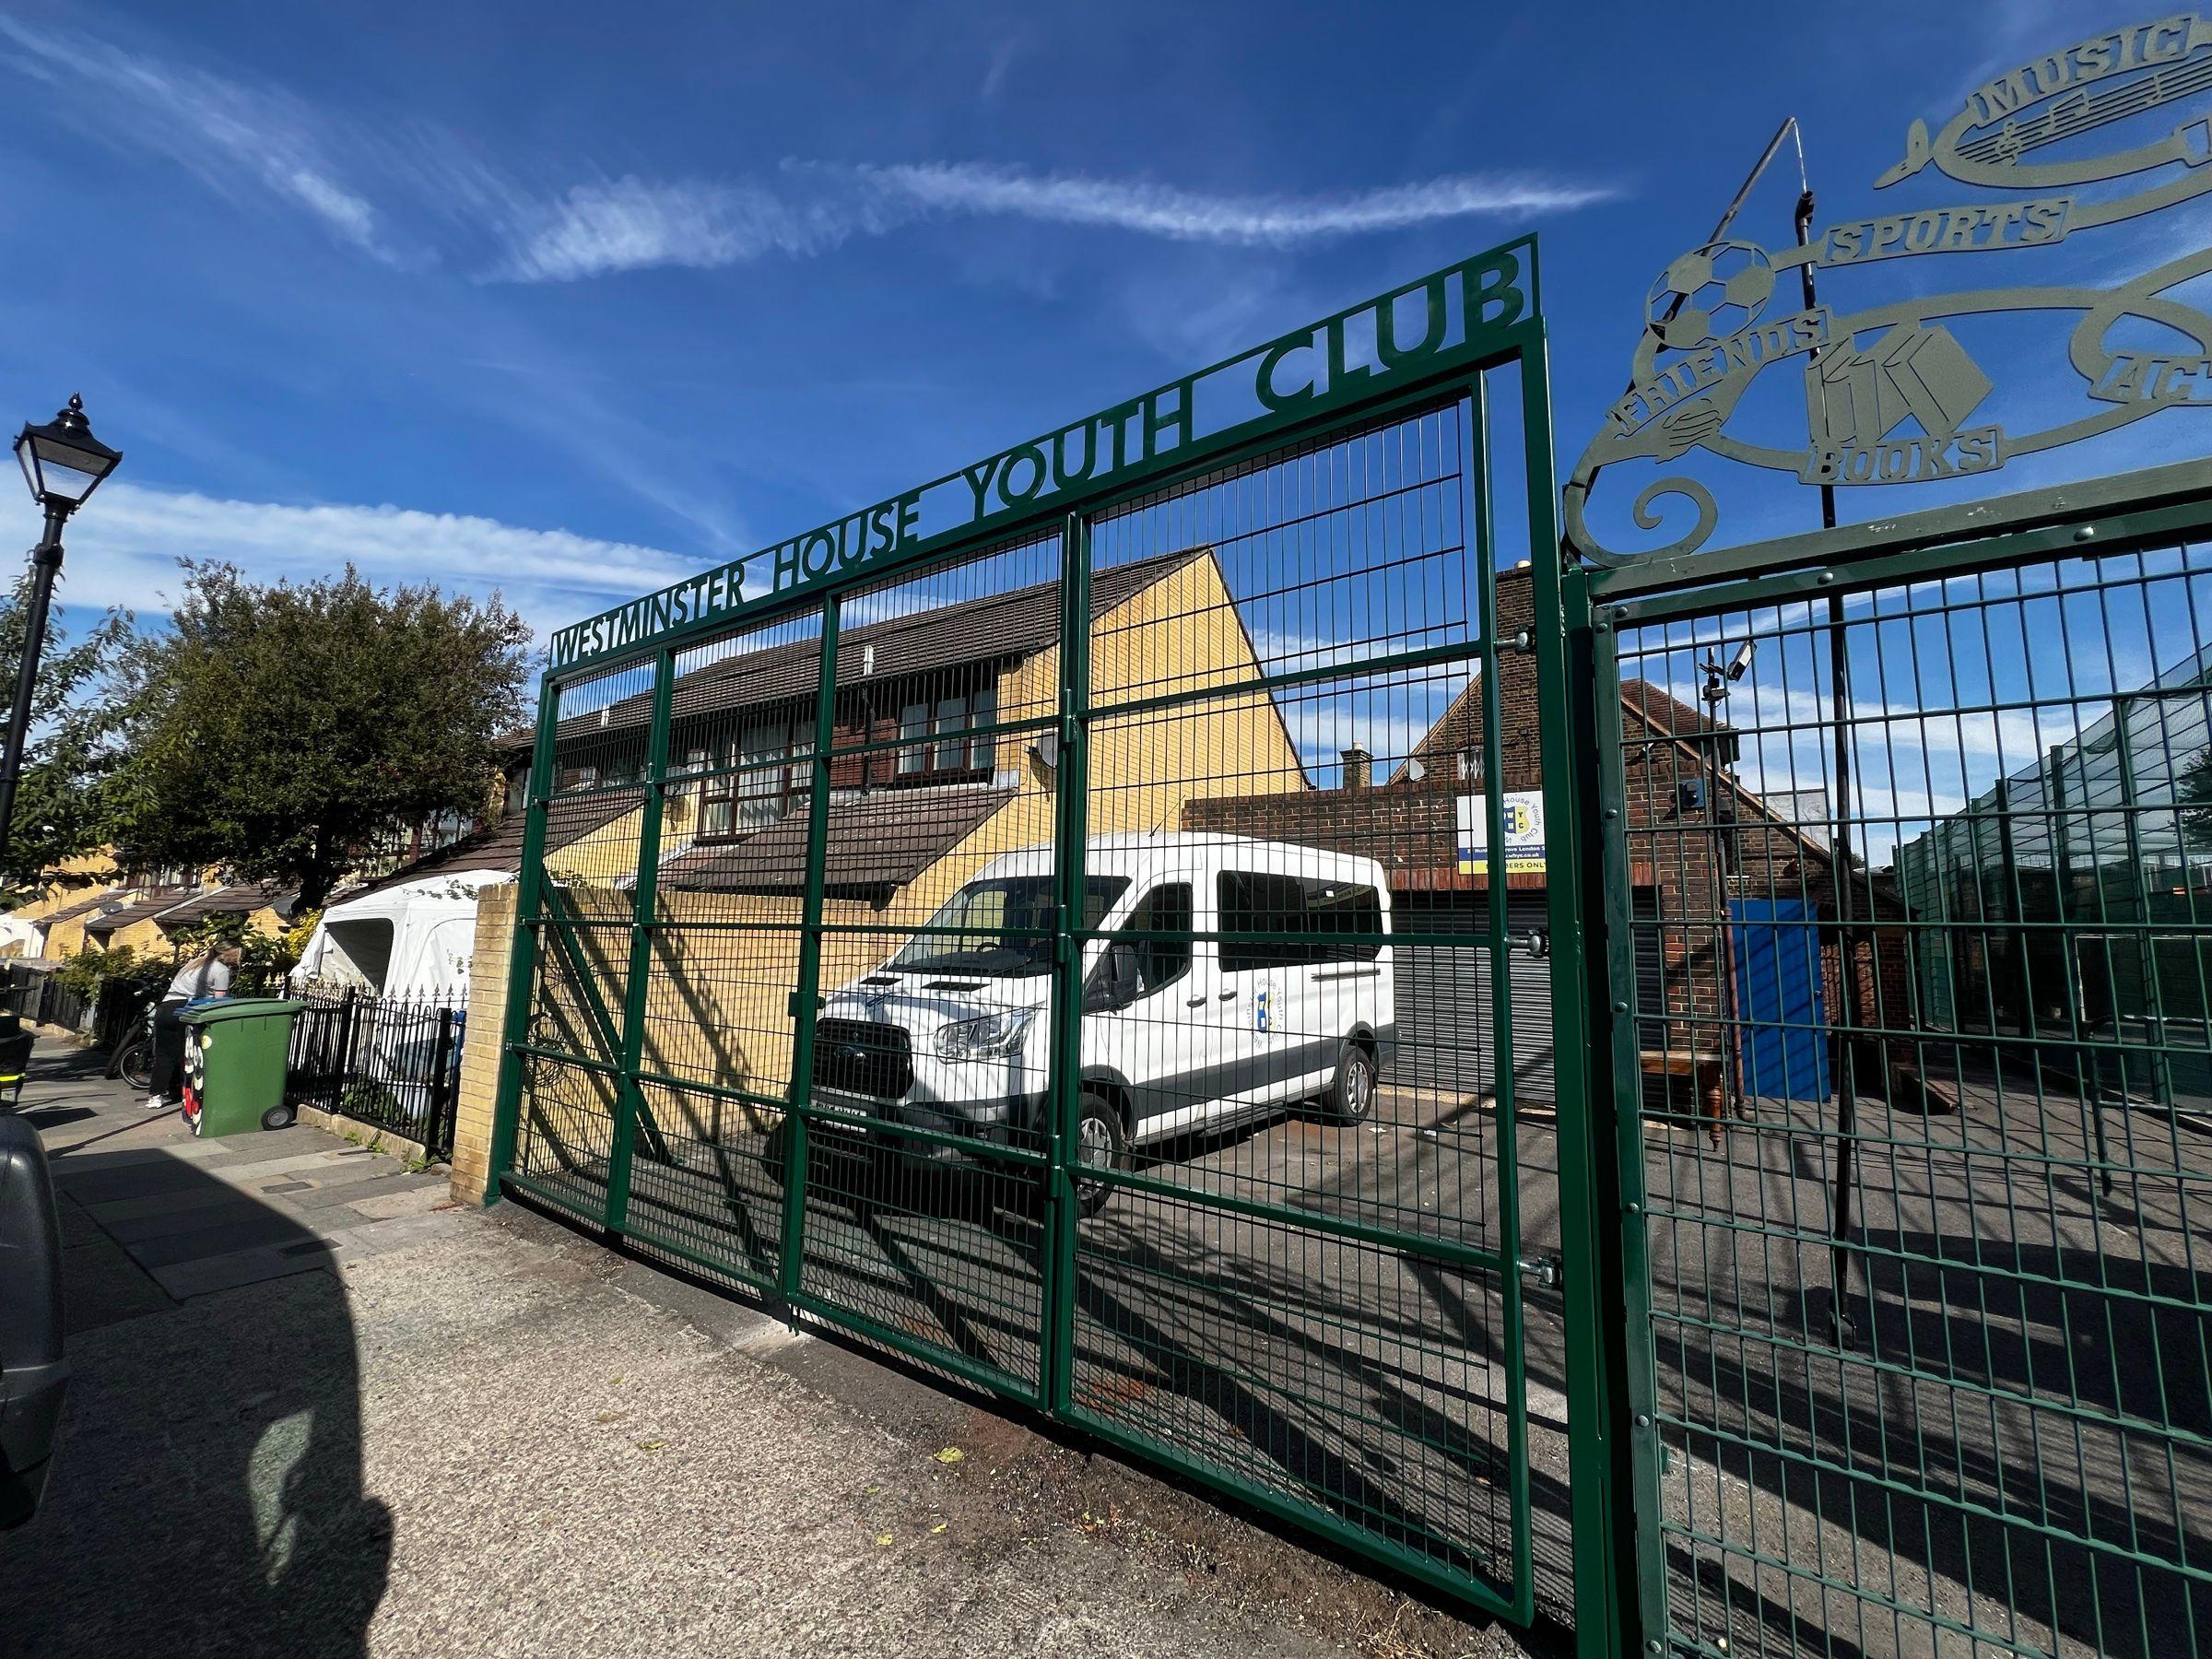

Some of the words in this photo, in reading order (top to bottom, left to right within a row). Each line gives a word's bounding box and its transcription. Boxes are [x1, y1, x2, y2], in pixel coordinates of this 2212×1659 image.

[1975, 18, 2186, 124] MUSIC
[1828, 201, 2065, 264] SPORTS
[1618, 311, 1826, 433] FRIENDS
[556, 563, 745, 665] WESTMINSTER
[773, 492, 919, 591] HOUSE
[962, 379, 1193, 520] YOUTH
[1255, 253, 1524, 410] CLUB
[1815, 429, 1995, 483] BOOKS
[1521, 828, 1538, 841] Club
[1531, 804, 1541, 826] Youth
